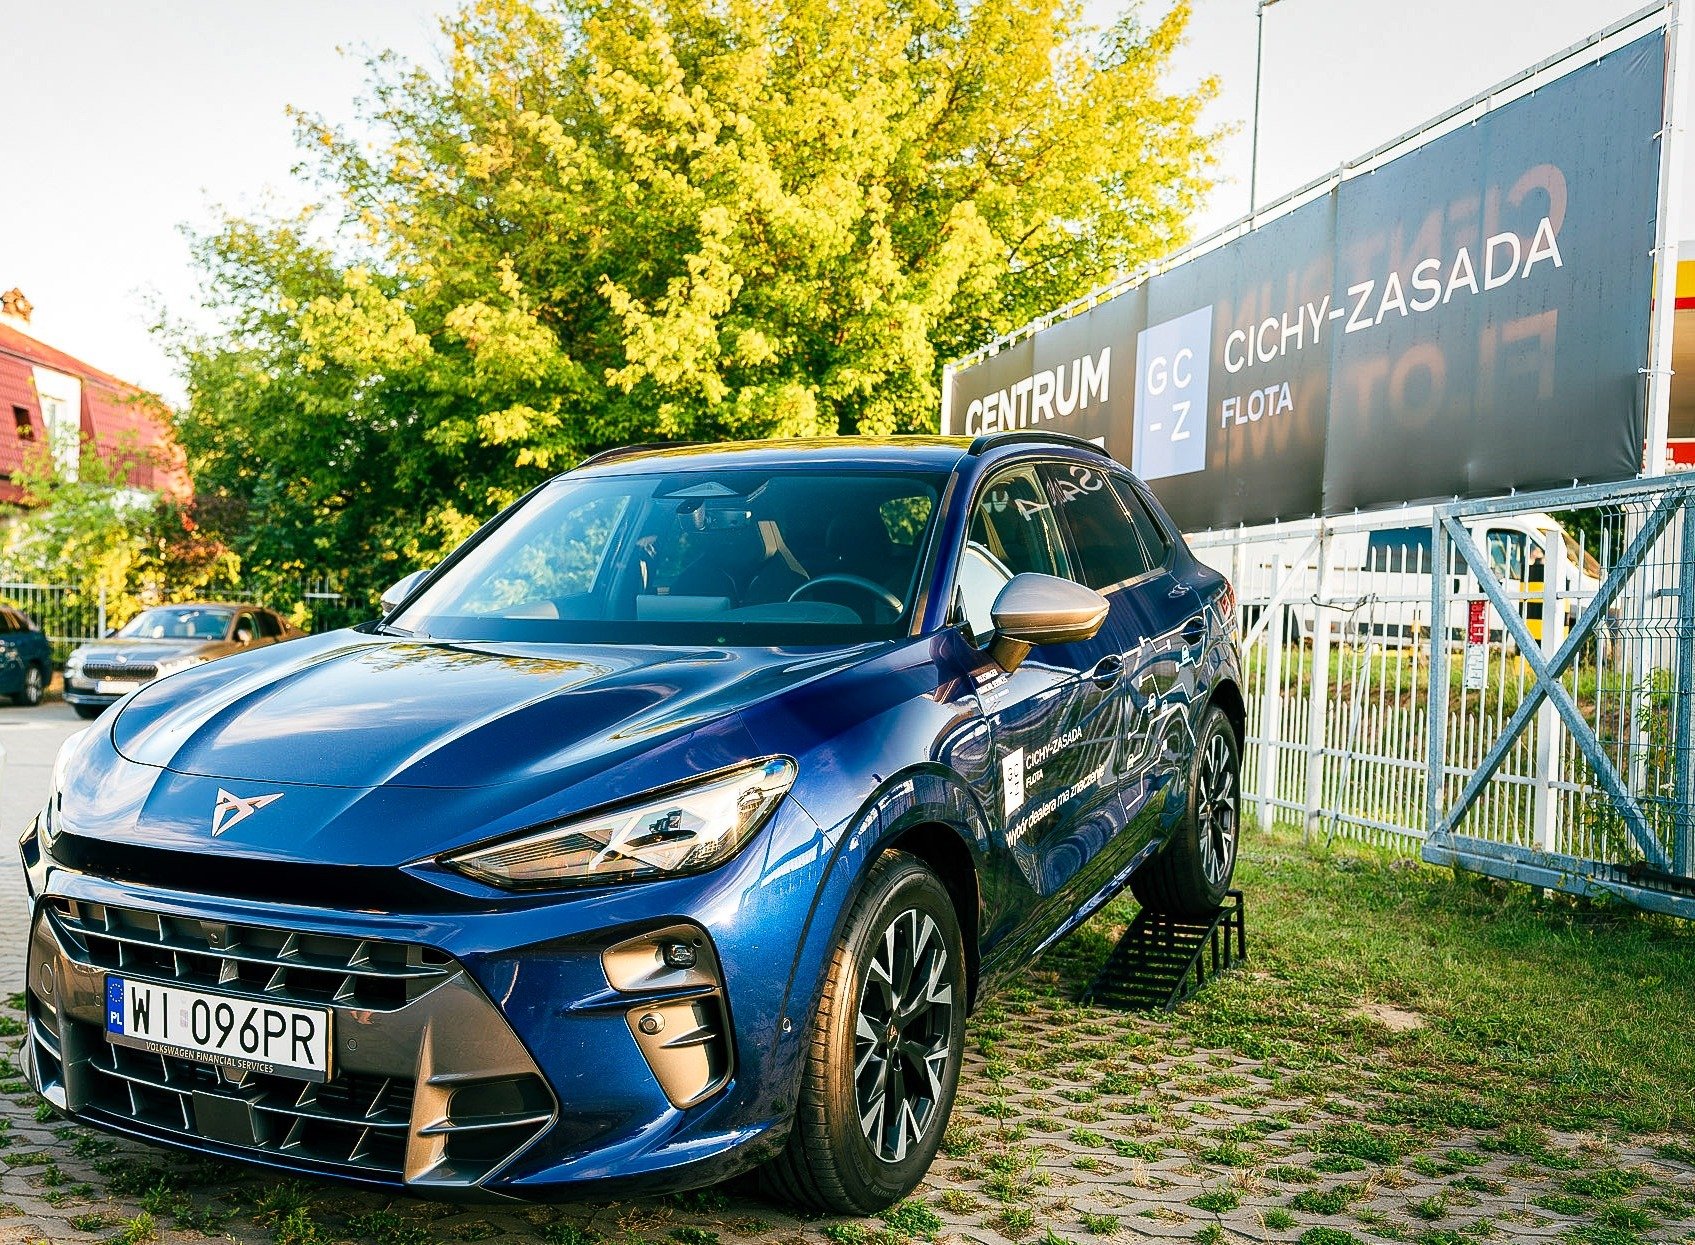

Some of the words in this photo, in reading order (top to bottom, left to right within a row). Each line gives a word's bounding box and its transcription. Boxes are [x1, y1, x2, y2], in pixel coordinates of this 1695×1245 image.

[1223, 216, 1563, 374] CICHY-ZASADA
[965, 346, 1111, 437] CENTRUM
[1221, 381, 1293, 428] FLOTA
[1025, 725, 1083, 770] CICHY-ZASADA
[1025, 768, 1044, 789] FLOTA
[1028, 798, 1057, 828] dealera
[1057, 789, 1070, 808] ma
[110, 1010, 123, 1026] PL
[131, 986, 168, 1039] WI
[191, 999, 315, 1065] 096PR
[145, 1041, 194, 1060] VOLKSWAGEN
[196, 1051, 237, 1068] FINANCIAL
[237, 1059, 274, 1074] SERVICES
